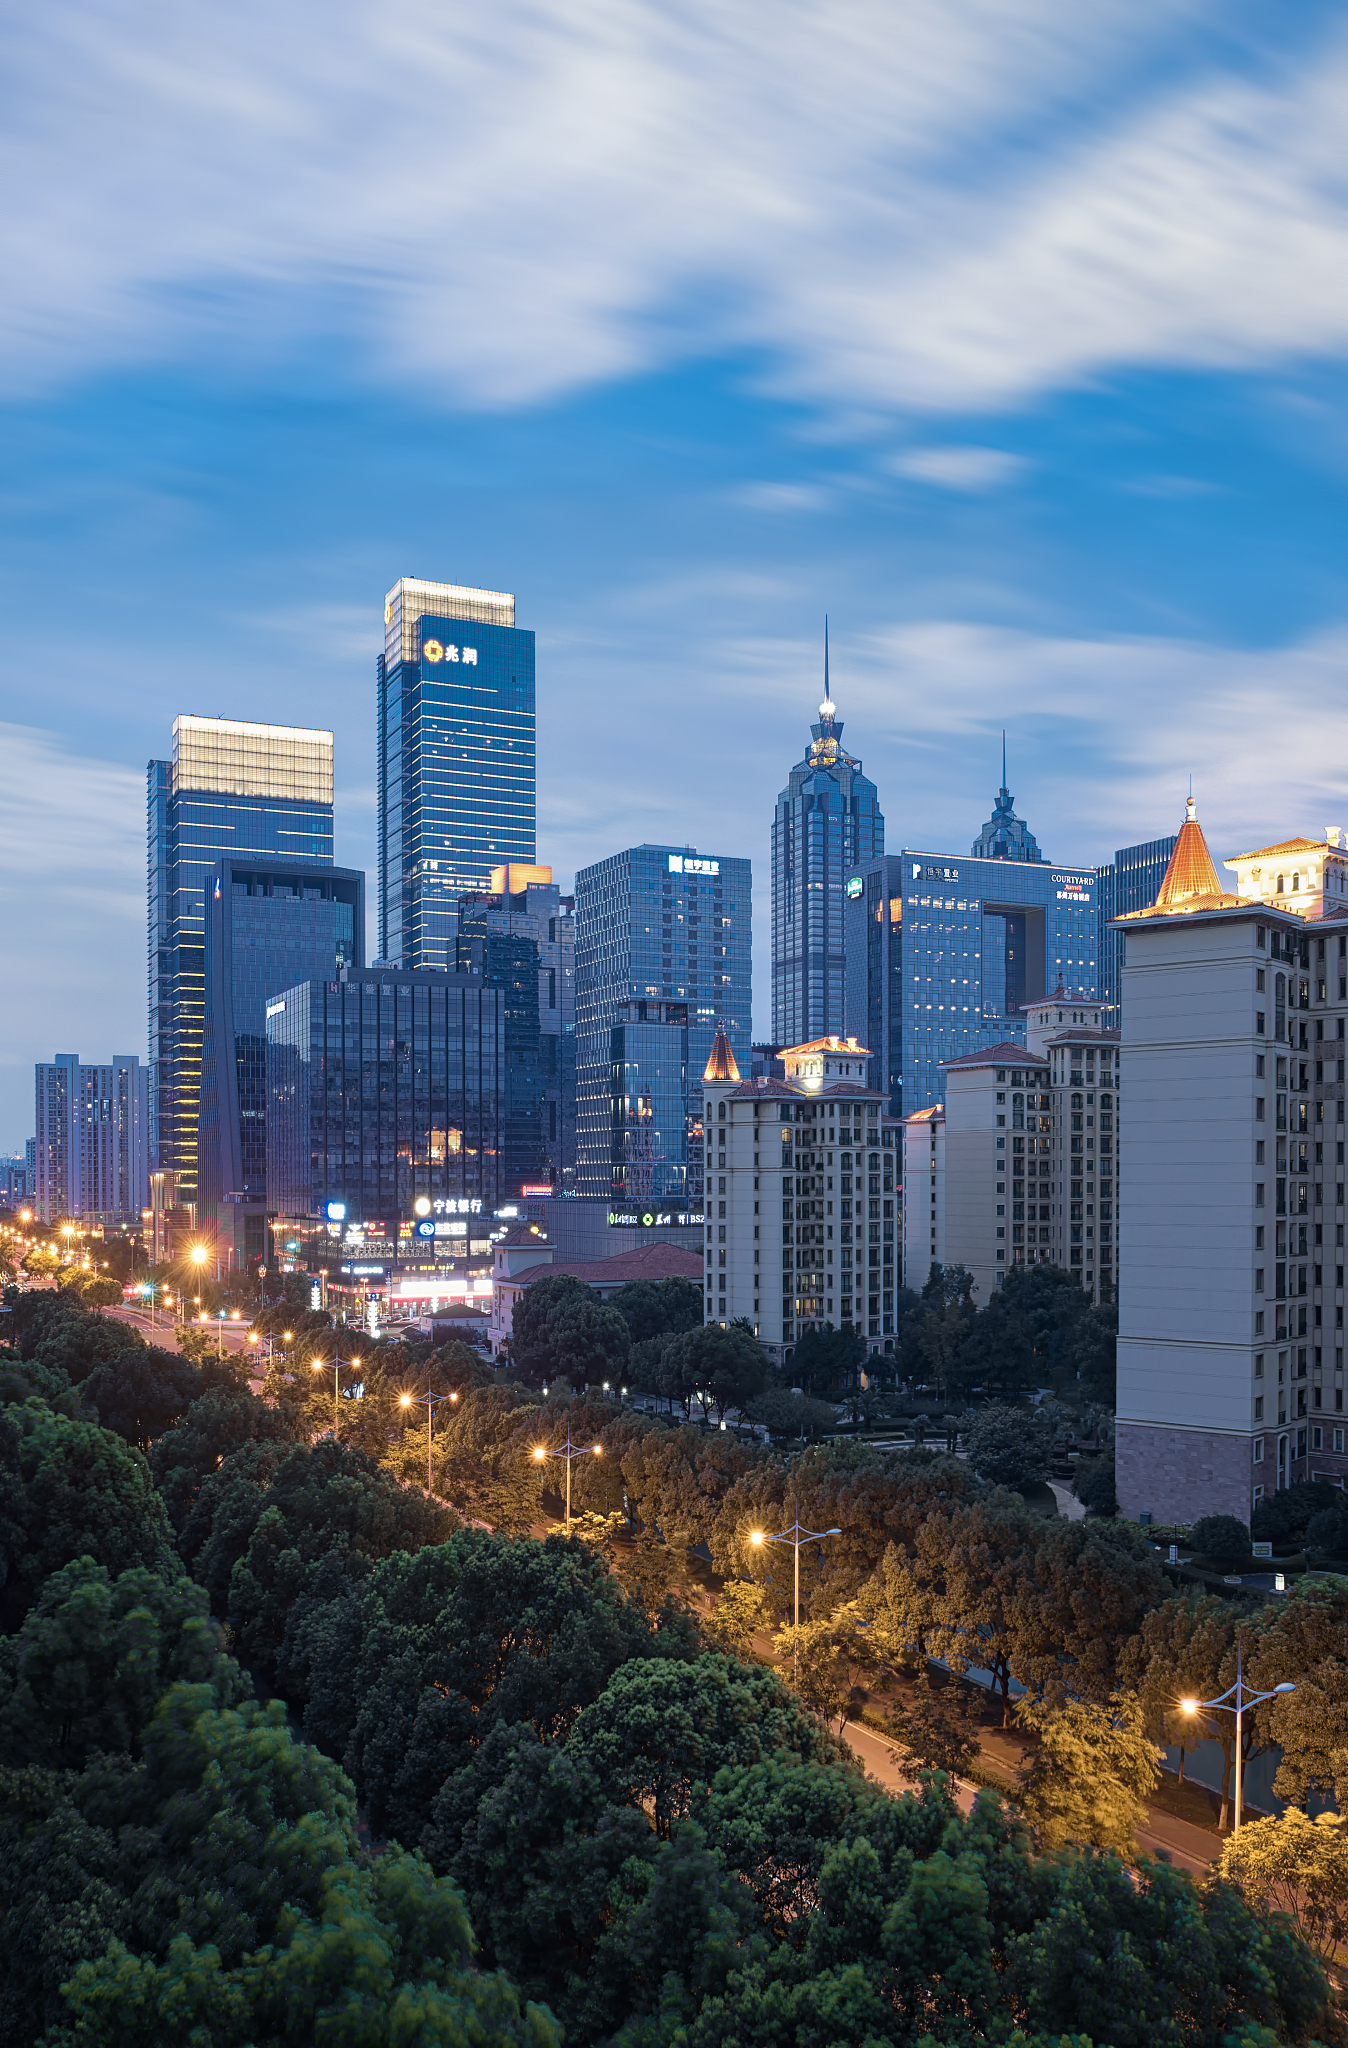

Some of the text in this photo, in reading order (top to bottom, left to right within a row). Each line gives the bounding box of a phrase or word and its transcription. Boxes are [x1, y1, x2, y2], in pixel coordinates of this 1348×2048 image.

[445, 644, 477, 666] 兆润
[1051, 874, 1094, 886] COURTYARD
[346, 983, 410, 997] 华盛置业
[433, 1198, 483, 1214] 宁波银行
